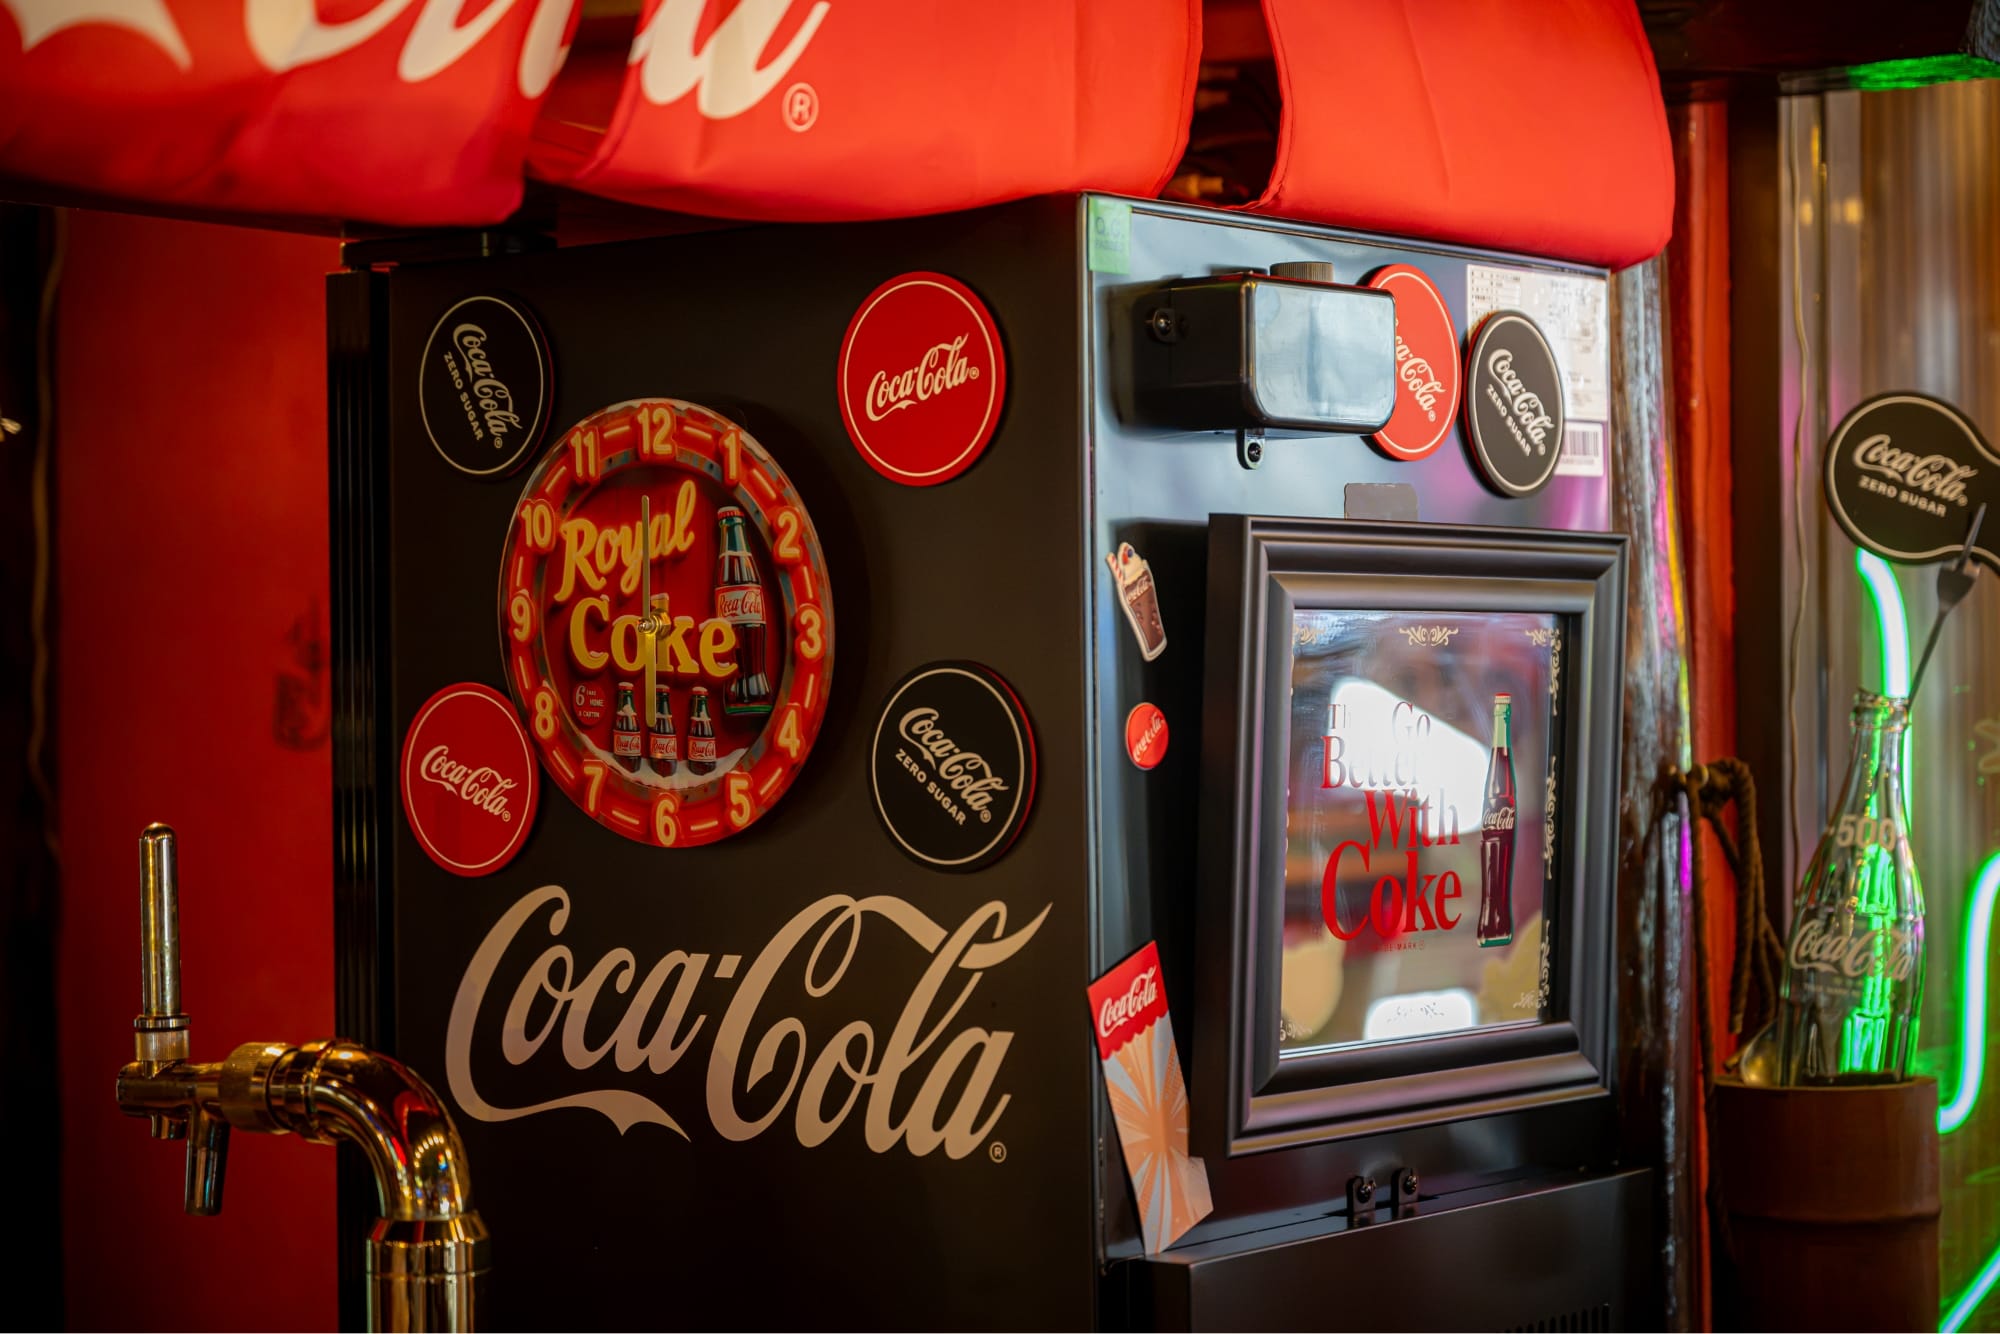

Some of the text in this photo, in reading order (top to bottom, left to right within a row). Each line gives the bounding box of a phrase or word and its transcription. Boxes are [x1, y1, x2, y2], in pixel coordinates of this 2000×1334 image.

[444, 351, 483, 440] ZERO SUGAR
[453, 323, 523, 437] Coca-Cola
[866, 332, 969, 421] Coca-Cola
[1395, 318, 1446, 411] ca-Cola
[1486, 383, 1532, 457] ZERO SUGAR
[1488, 348, 1555, 445] Coca-Cola
[570, 430, 598, 478] 11
[638, 407, 672, 454] 12
[724, 432, 739, 480] 1
[1853, 433, 1979, 502] Coca-Cola
[1858, 475, 1947, 518] ZERO SUGAR
[521, 504, 551, 548] 10
[554, 480, 697, 601] Royal
[777, 512, 800, 558] 2
[511, 600, 531, 642] 9
[570, 593, 738, 677] Coke
[801, 610, 822, 656] 3
[535, 694, 555, 738] 8
[575, 685, 586, 706] 6
[778, 709, 800, 758] 4
[899, 707, 1010, 811] Coca-Cola
[420, 745, 518, 815] Coca-Cola
[583, 765, 605, 811] 7
[730, 778, 752, 827] 5
[895, 748, 967, 826] ZERO SUGAR
[656, 800, 676, 845] 6
[1364, 788, 1460, 850] With
[1837, 815, 1896, 851] 500
[1321, 840, 1462, 941] Coke
[445, 885, 1053, 1160] Coca-Cola
[1099, 965, 1158, 1038] Coca-Cola
